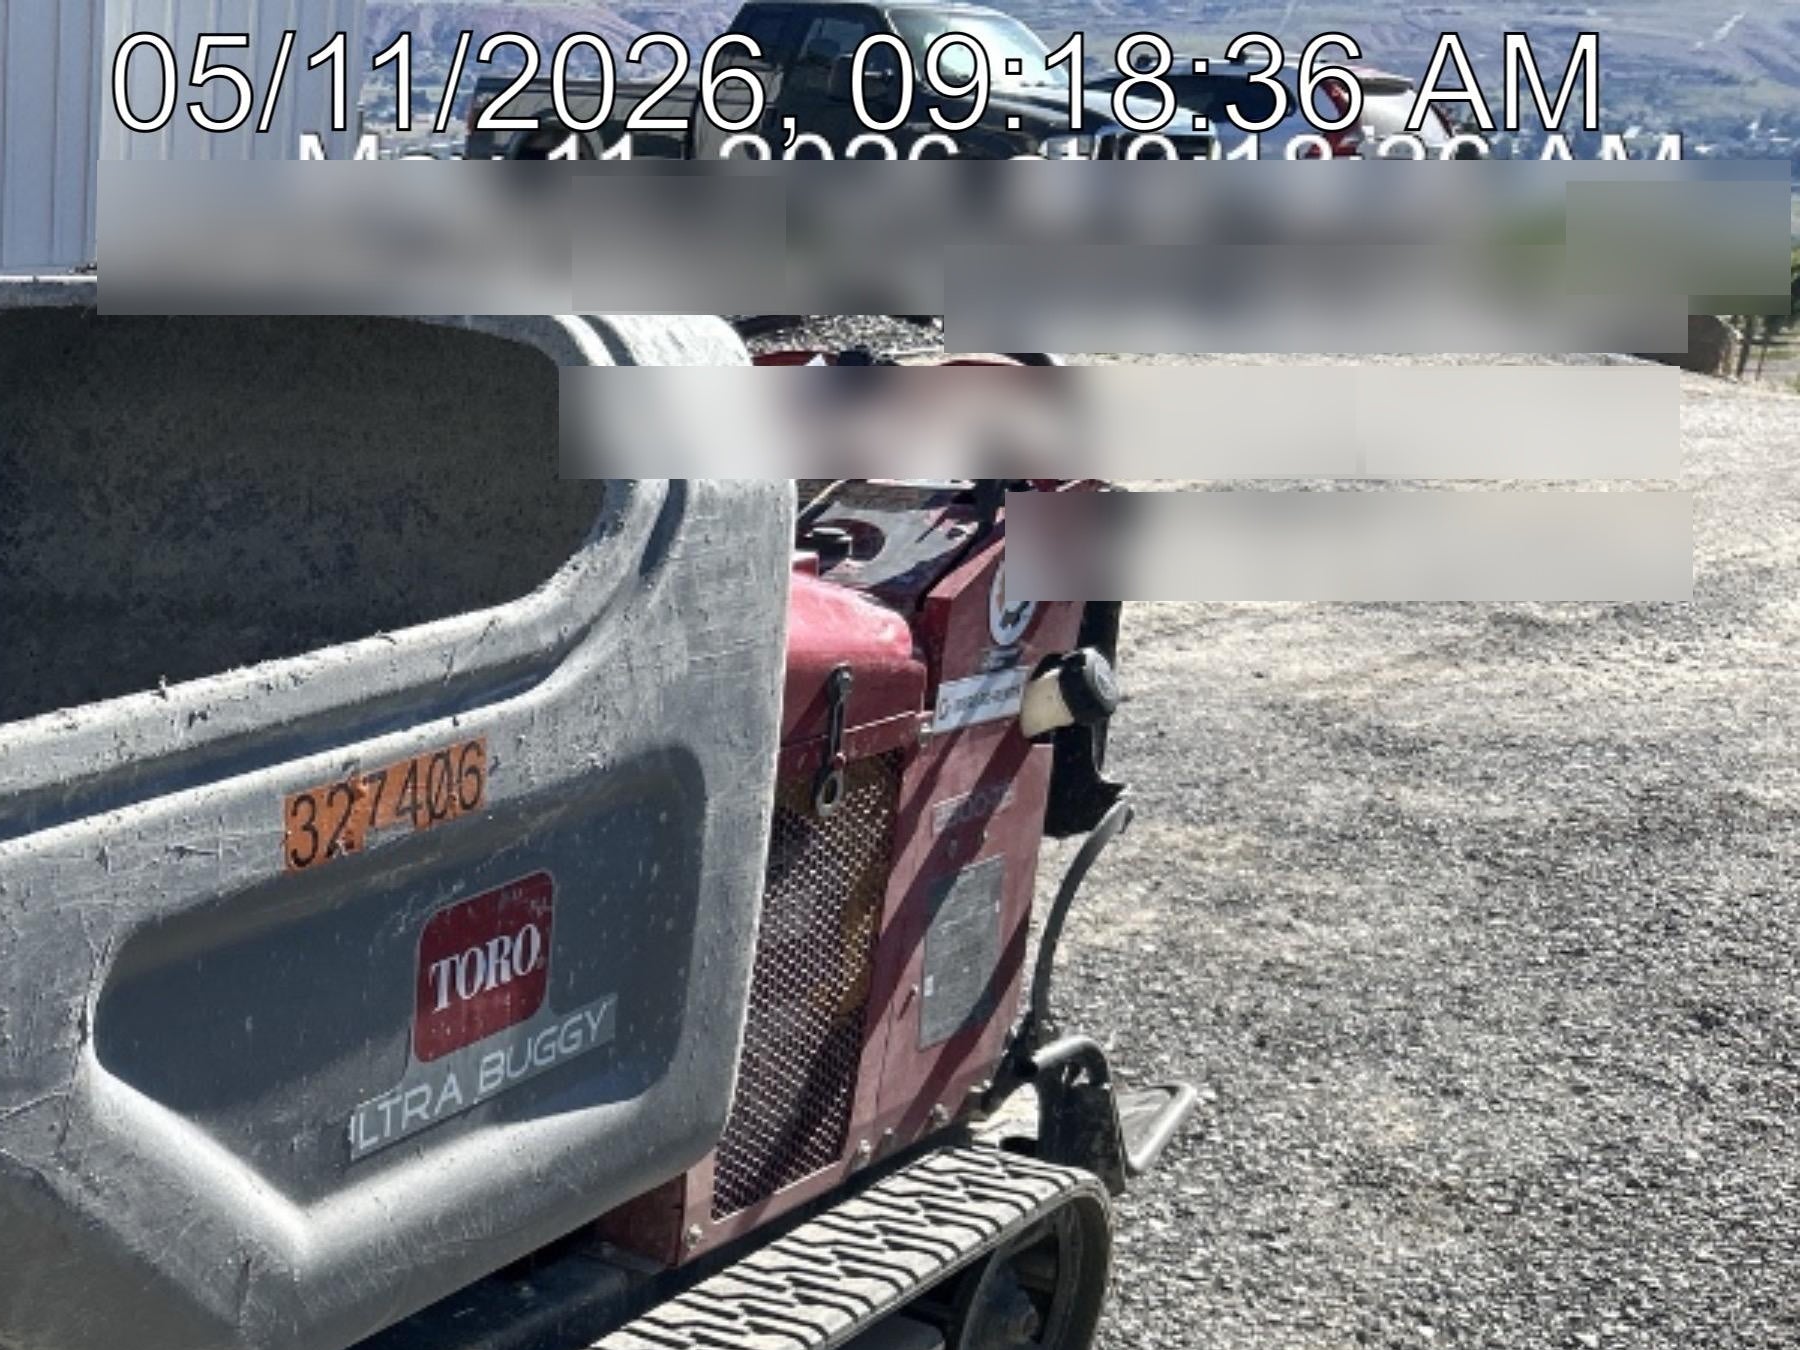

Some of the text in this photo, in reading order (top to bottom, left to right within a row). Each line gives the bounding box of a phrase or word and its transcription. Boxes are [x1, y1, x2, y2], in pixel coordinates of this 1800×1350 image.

[290, 741, 483, 868] 327406
[428, 923, 542, 1015] TORO
[478, 1001, 612, 1093] BUGGY
